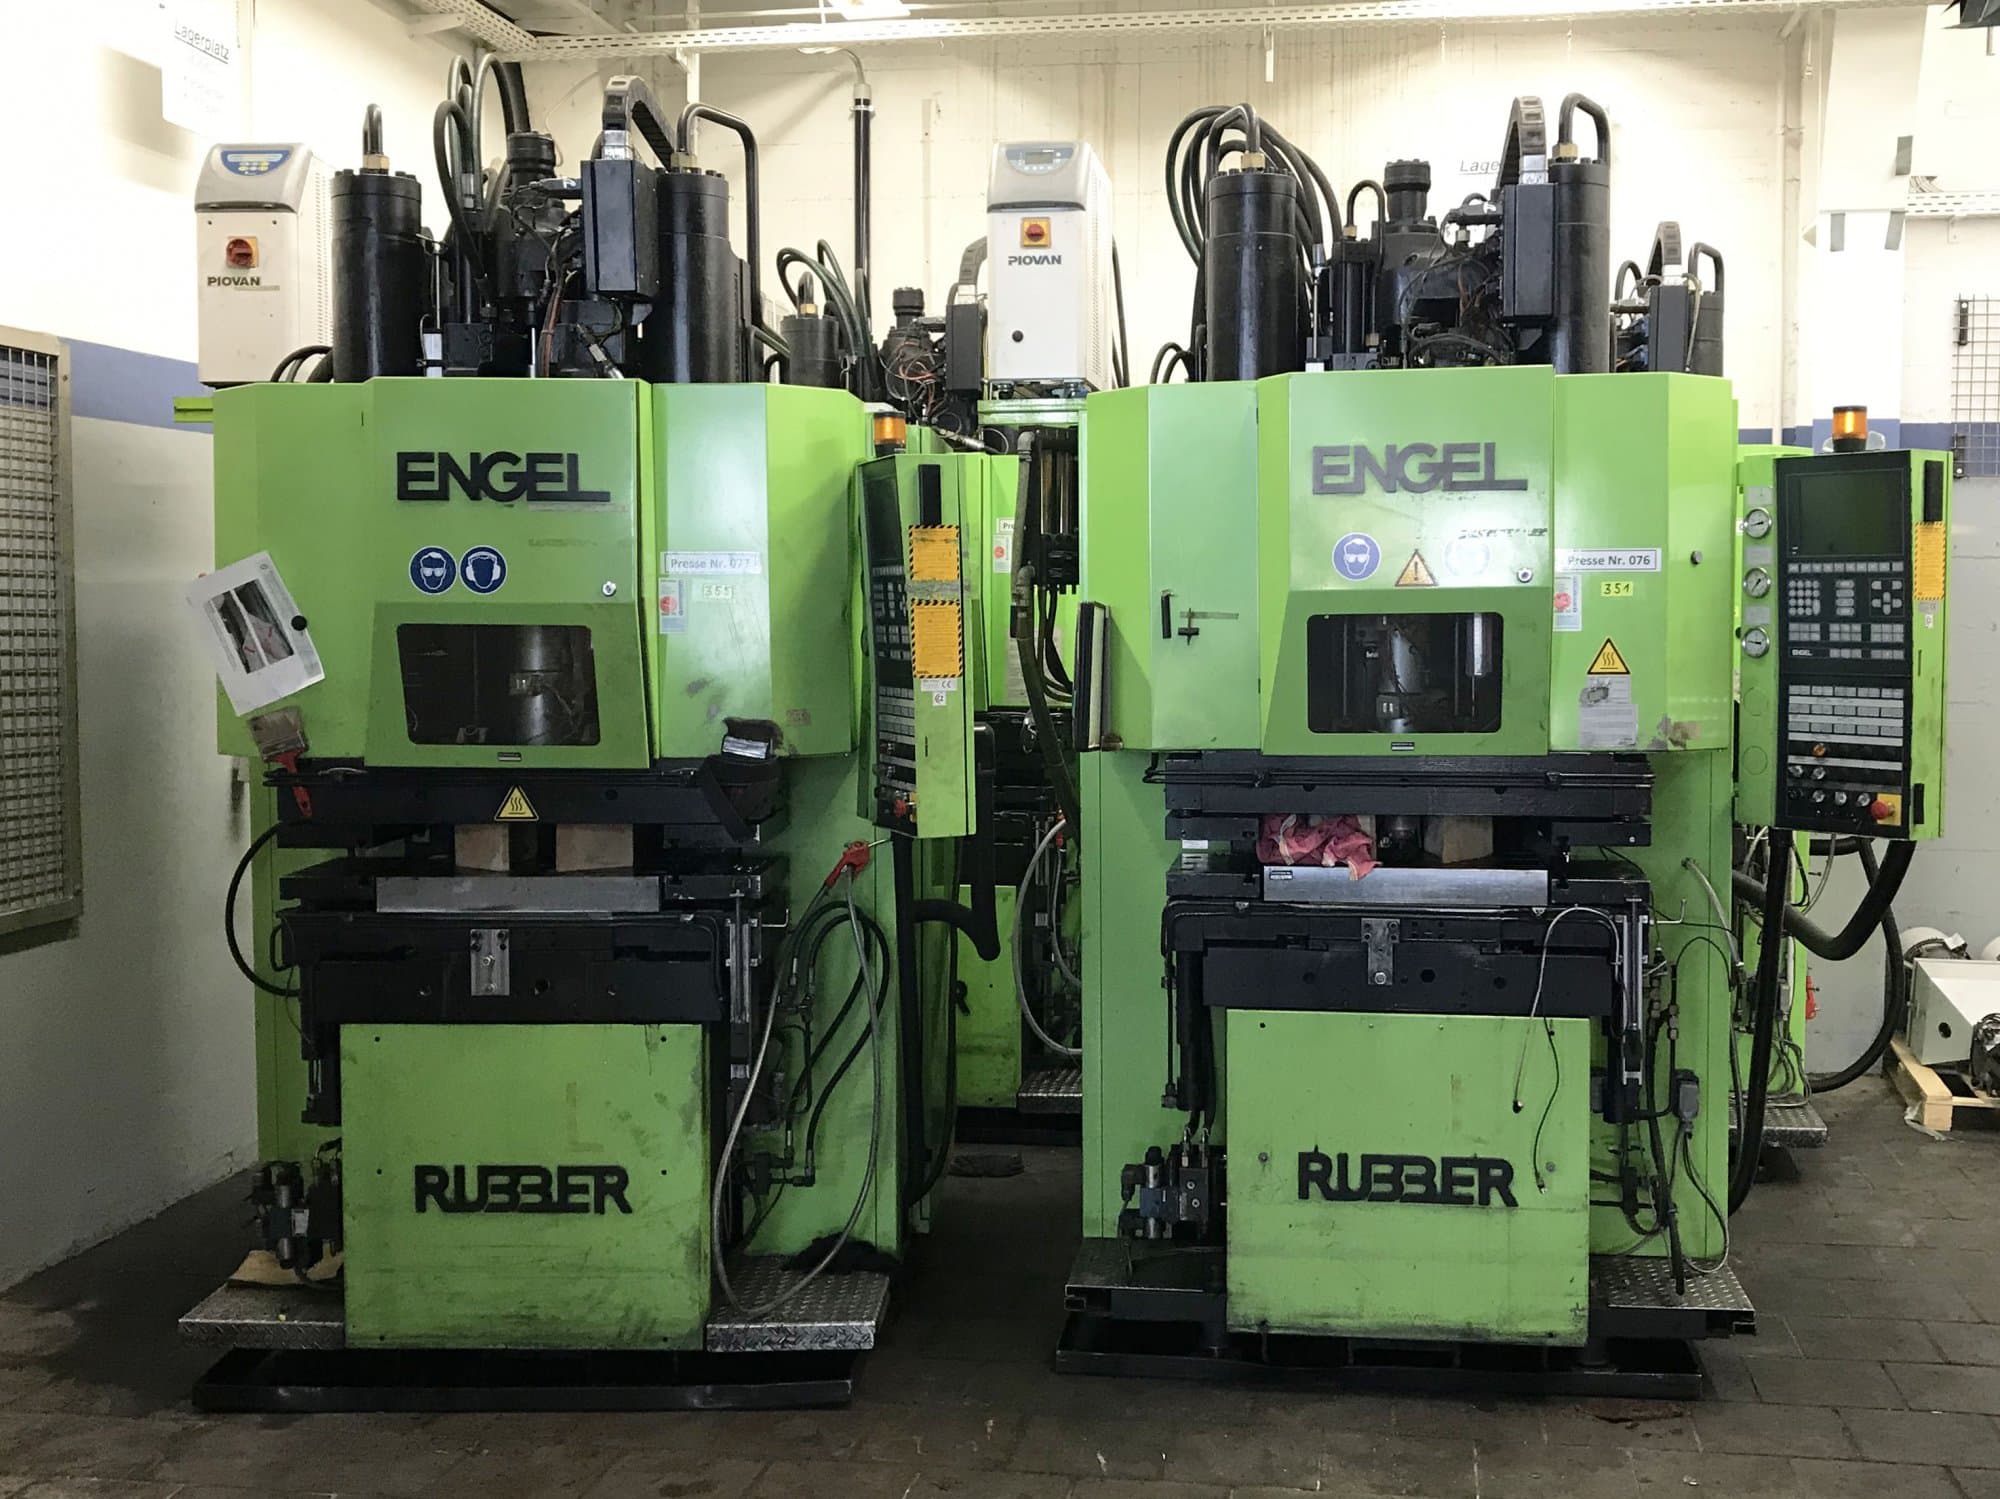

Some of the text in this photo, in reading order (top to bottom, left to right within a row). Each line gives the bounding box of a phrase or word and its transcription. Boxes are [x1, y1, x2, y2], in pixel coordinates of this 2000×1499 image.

[174, 18, 229, 60] Lagerplatz
[1007, 254, 1063, 266] PIOVAN
[206, 276, 261, 287] PIOVAN
[396, 451, 611, 502] ENGEL
[1312, 442, 1529, 495] ENGEL
[670, 558, 707, 569] Presse
[710, 559, 727, 569] Nr.
[1567, 555, 1651, 566] Presse Nr. 076
[1604, 583, 1630, 595] 351
[414, 1164, 633, 1215] RUBBER
[1297, 1150, 1519, 1208] RUBBER
